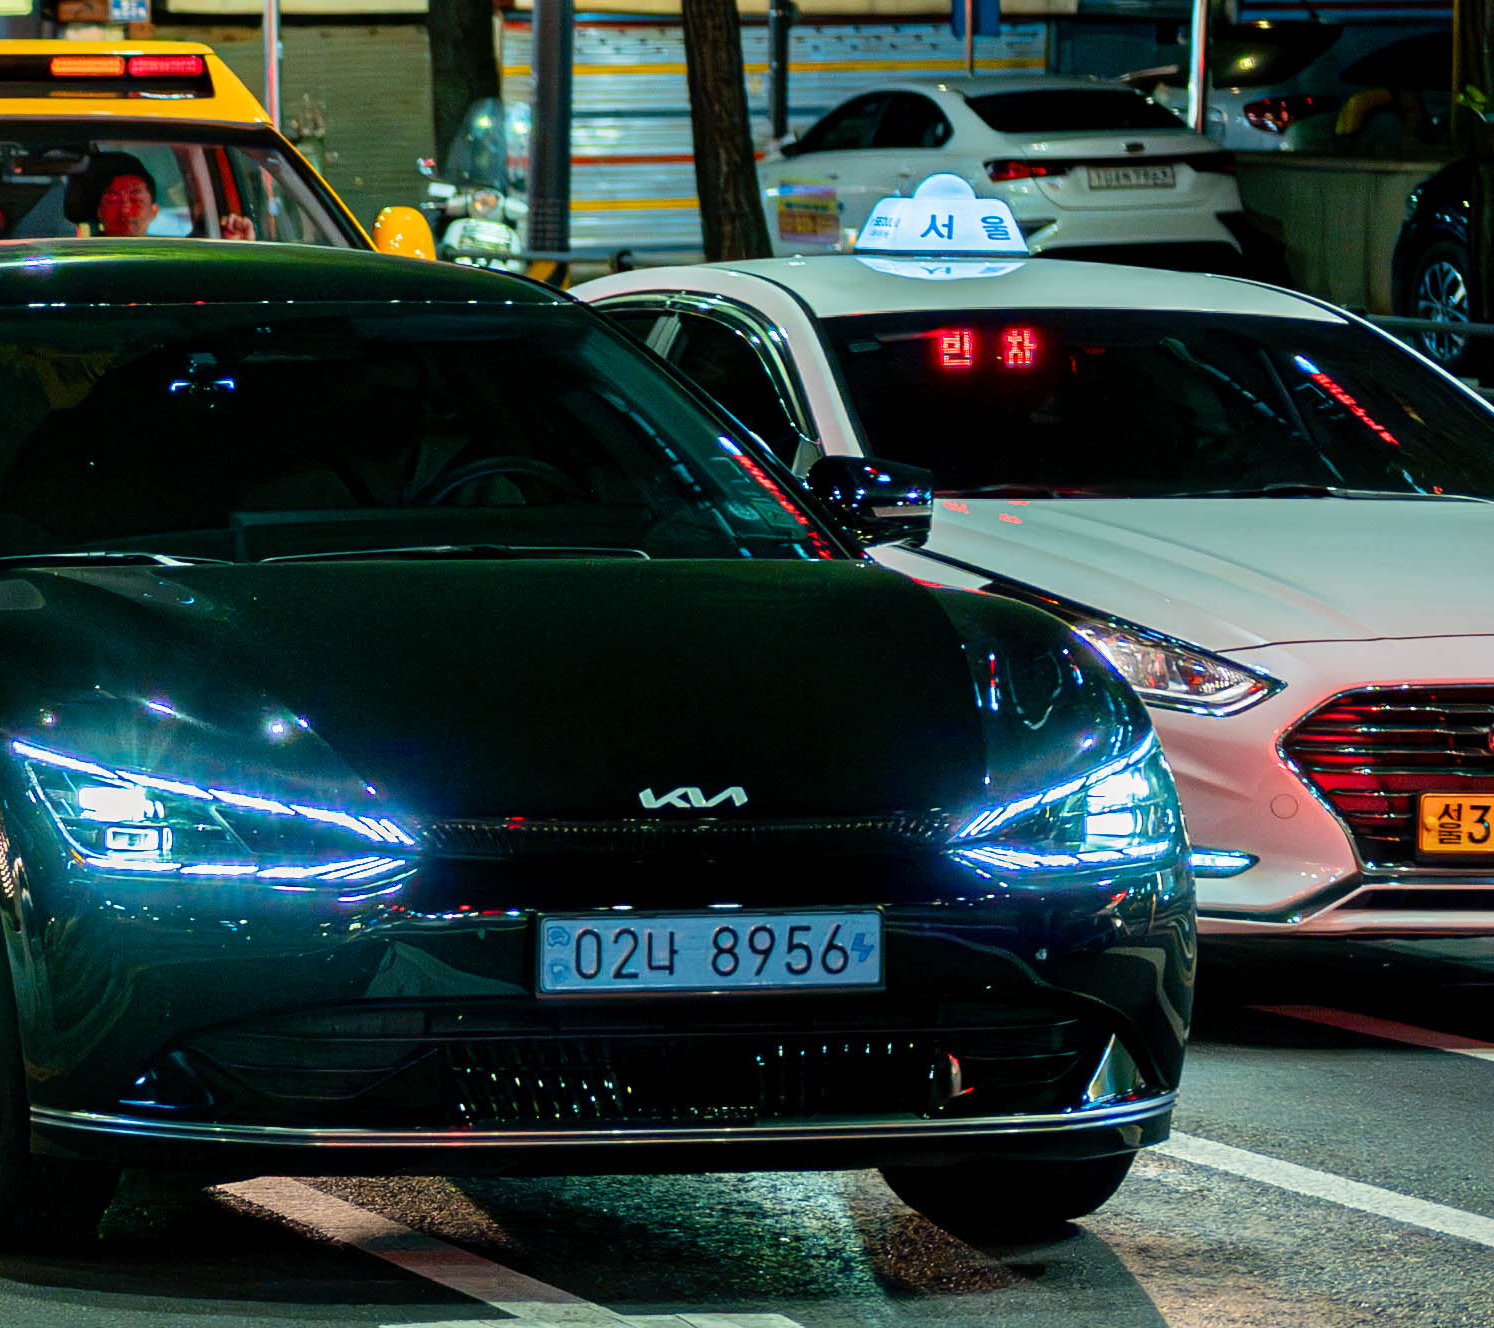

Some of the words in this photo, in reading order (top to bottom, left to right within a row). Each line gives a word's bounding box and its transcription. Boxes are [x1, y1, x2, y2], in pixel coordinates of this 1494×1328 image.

[919, 213, 1013, 241] 서울
[1437, 802, 1463, 845] 서울
[574, 927, 678, 980] 02나
[711, 923, 850, 978] 8956
